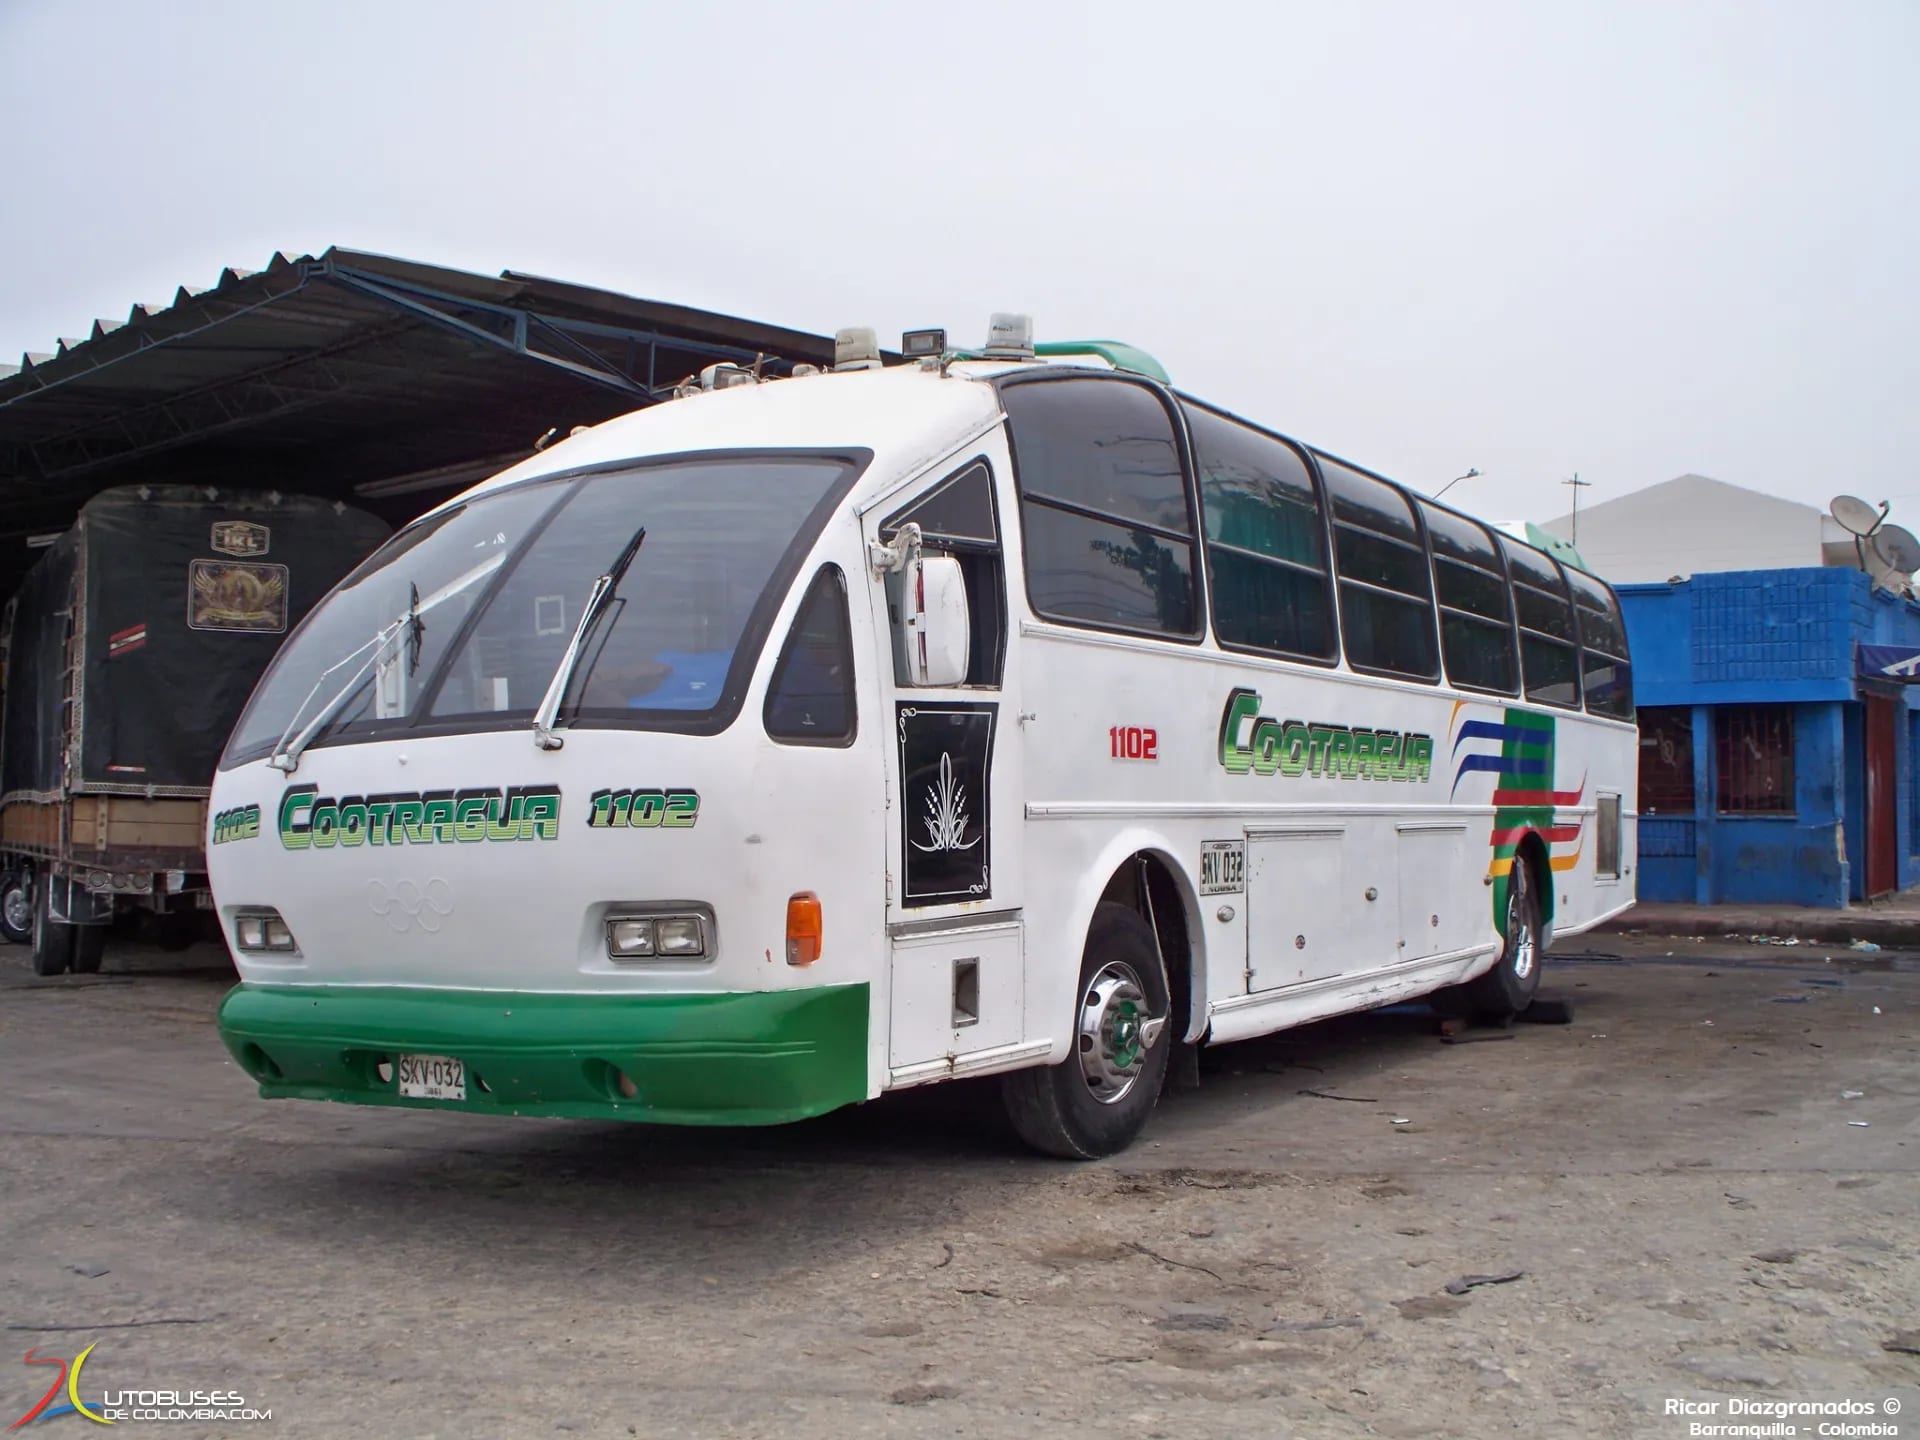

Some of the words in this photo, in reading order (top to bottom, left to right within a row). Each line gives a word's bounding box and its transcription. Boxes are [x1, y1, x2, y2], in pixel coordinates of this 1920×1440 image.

[1109, 725, 1157, 760] 1102
[213, 804, 260, 845] 1102
[586, 788, 701, 828] 1102
[1202, 852, 1220, 884] SKV
[1223, 851, 1242, 882] 032
